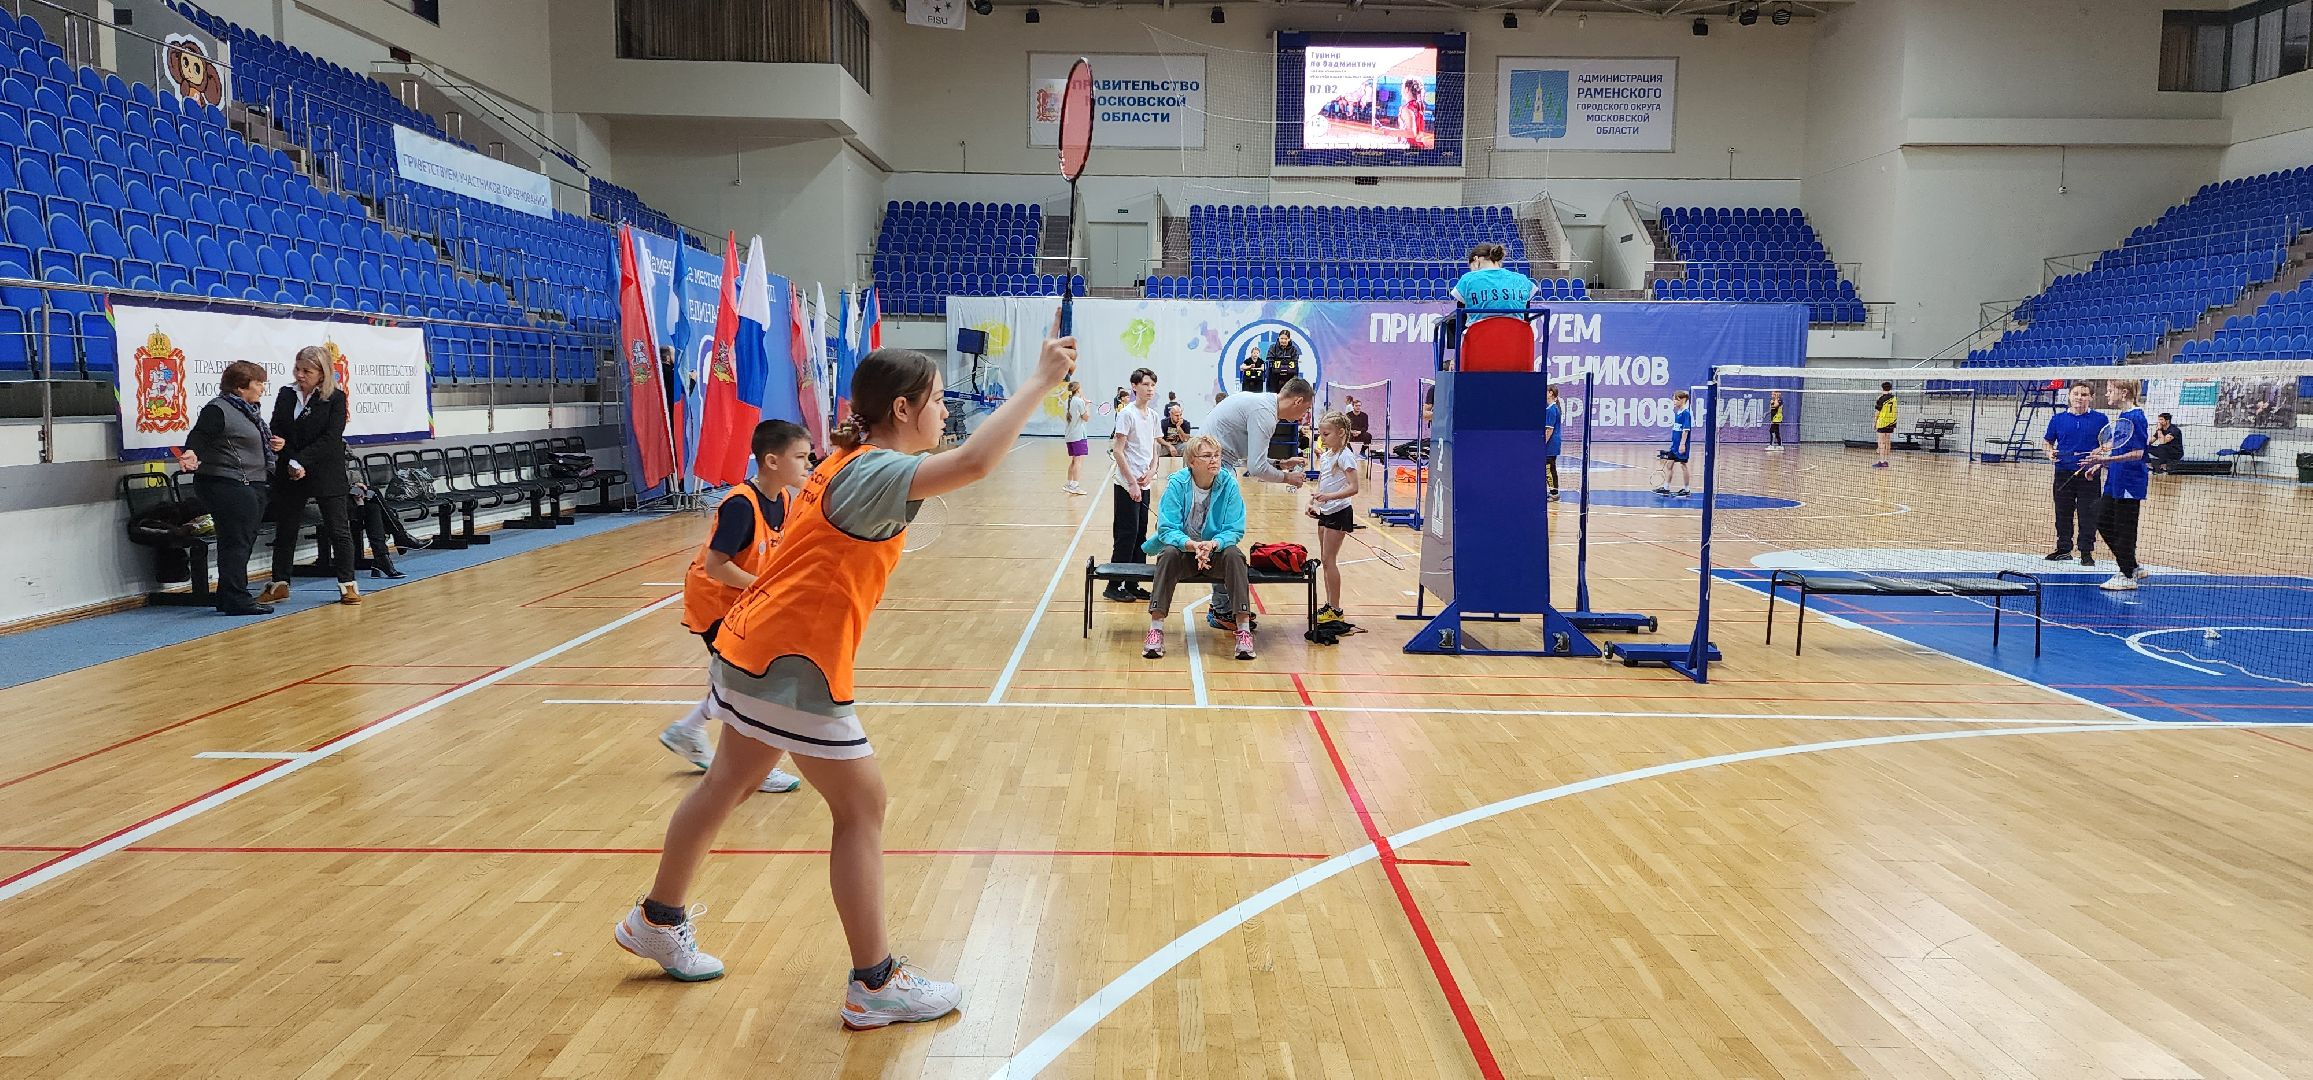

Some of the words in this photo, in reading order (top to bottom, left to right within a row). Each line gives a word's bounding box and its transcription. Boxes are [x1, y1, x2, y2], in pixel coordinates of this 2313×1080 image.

[927, 15, 948, 25] FISU
[1577, 74, 1663, 84] АДМИНИСТРАЦИЯ
[1072, 79, 1200, 92] ПРАВИТЕЛЬСТВО
[1577, 87, 1662, 99] РАМЕНСКОГО
[1576, 103, 1629, 112] ГОРОДСКОГО
[1630, 103, 1662, 111] ОКРУГА
[1101, 112, 1171, 123] ОБЛАСТИ
[1586, 112, 1650, 122] МОСКОВСКОЙ
[1596, 126, 1640, 135] ОБЛАСТИ
[402, 153, 458, 181] ПРИВЕТСТВУЕМ
[458, 171, 502, 195] УЧАСТНИКОВ
[1471, 287, 1524, 306] RUSSIA
[355, 381, 411, 395] МОСКОВСКОЙ
[355, 401, 394, 414] ОБЛАСТИ
